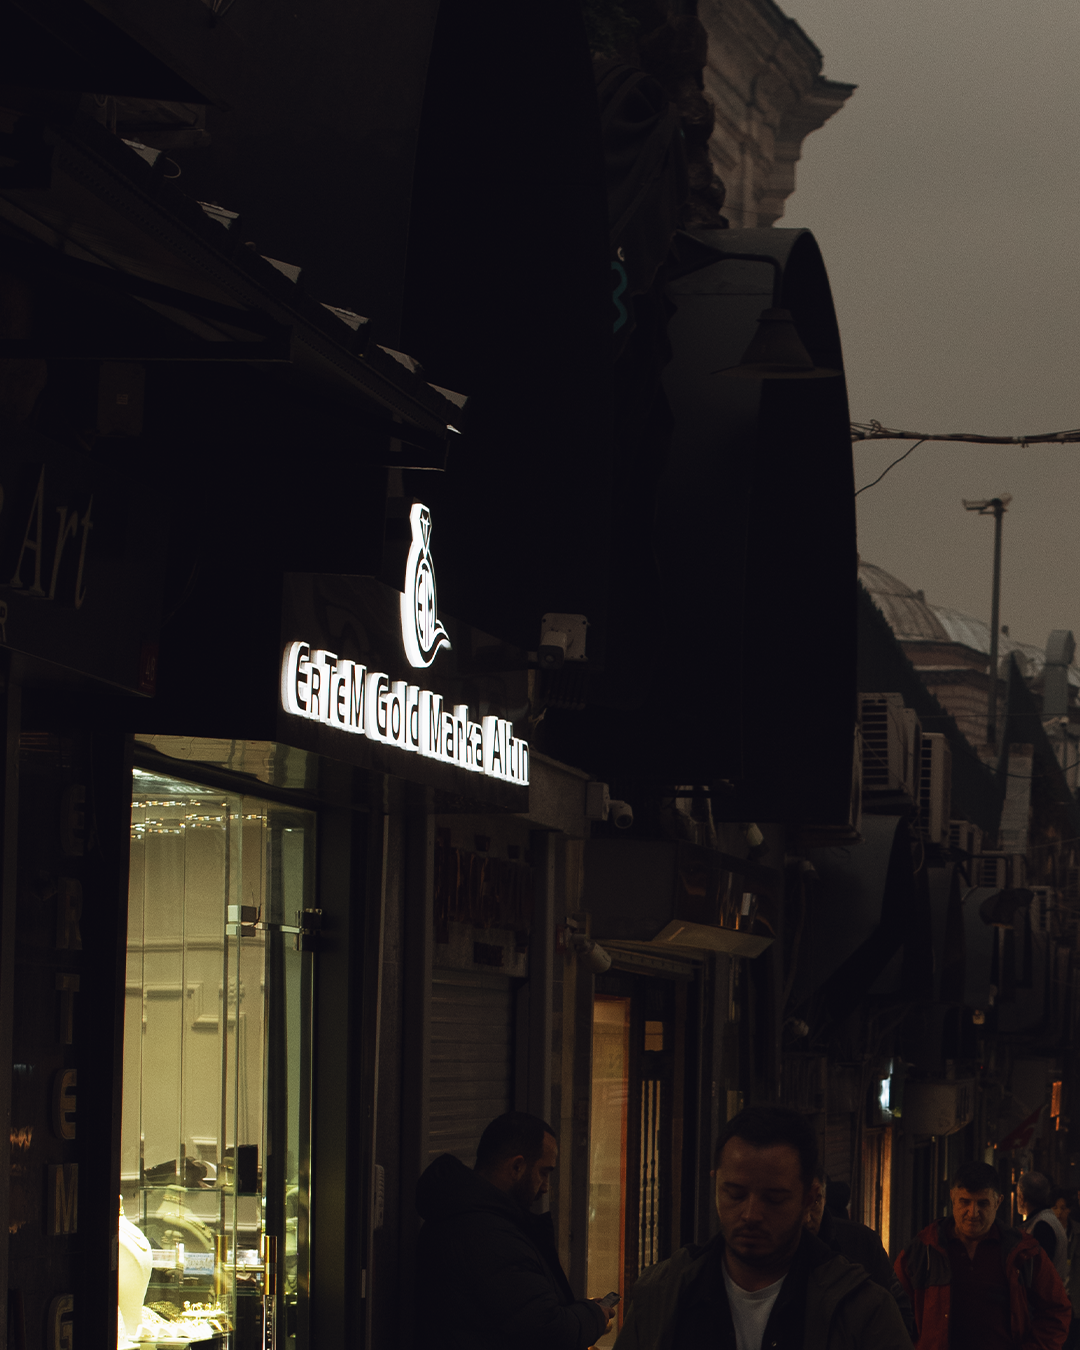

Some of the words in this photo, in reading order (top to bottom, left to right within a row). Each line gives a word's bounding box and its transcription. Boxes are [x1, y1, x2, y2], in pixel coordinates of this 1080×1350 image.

[10, 463, 94, 610] Art
[365, 672, 420, 752] Gold
[417, 690, 485, 772] Marka
